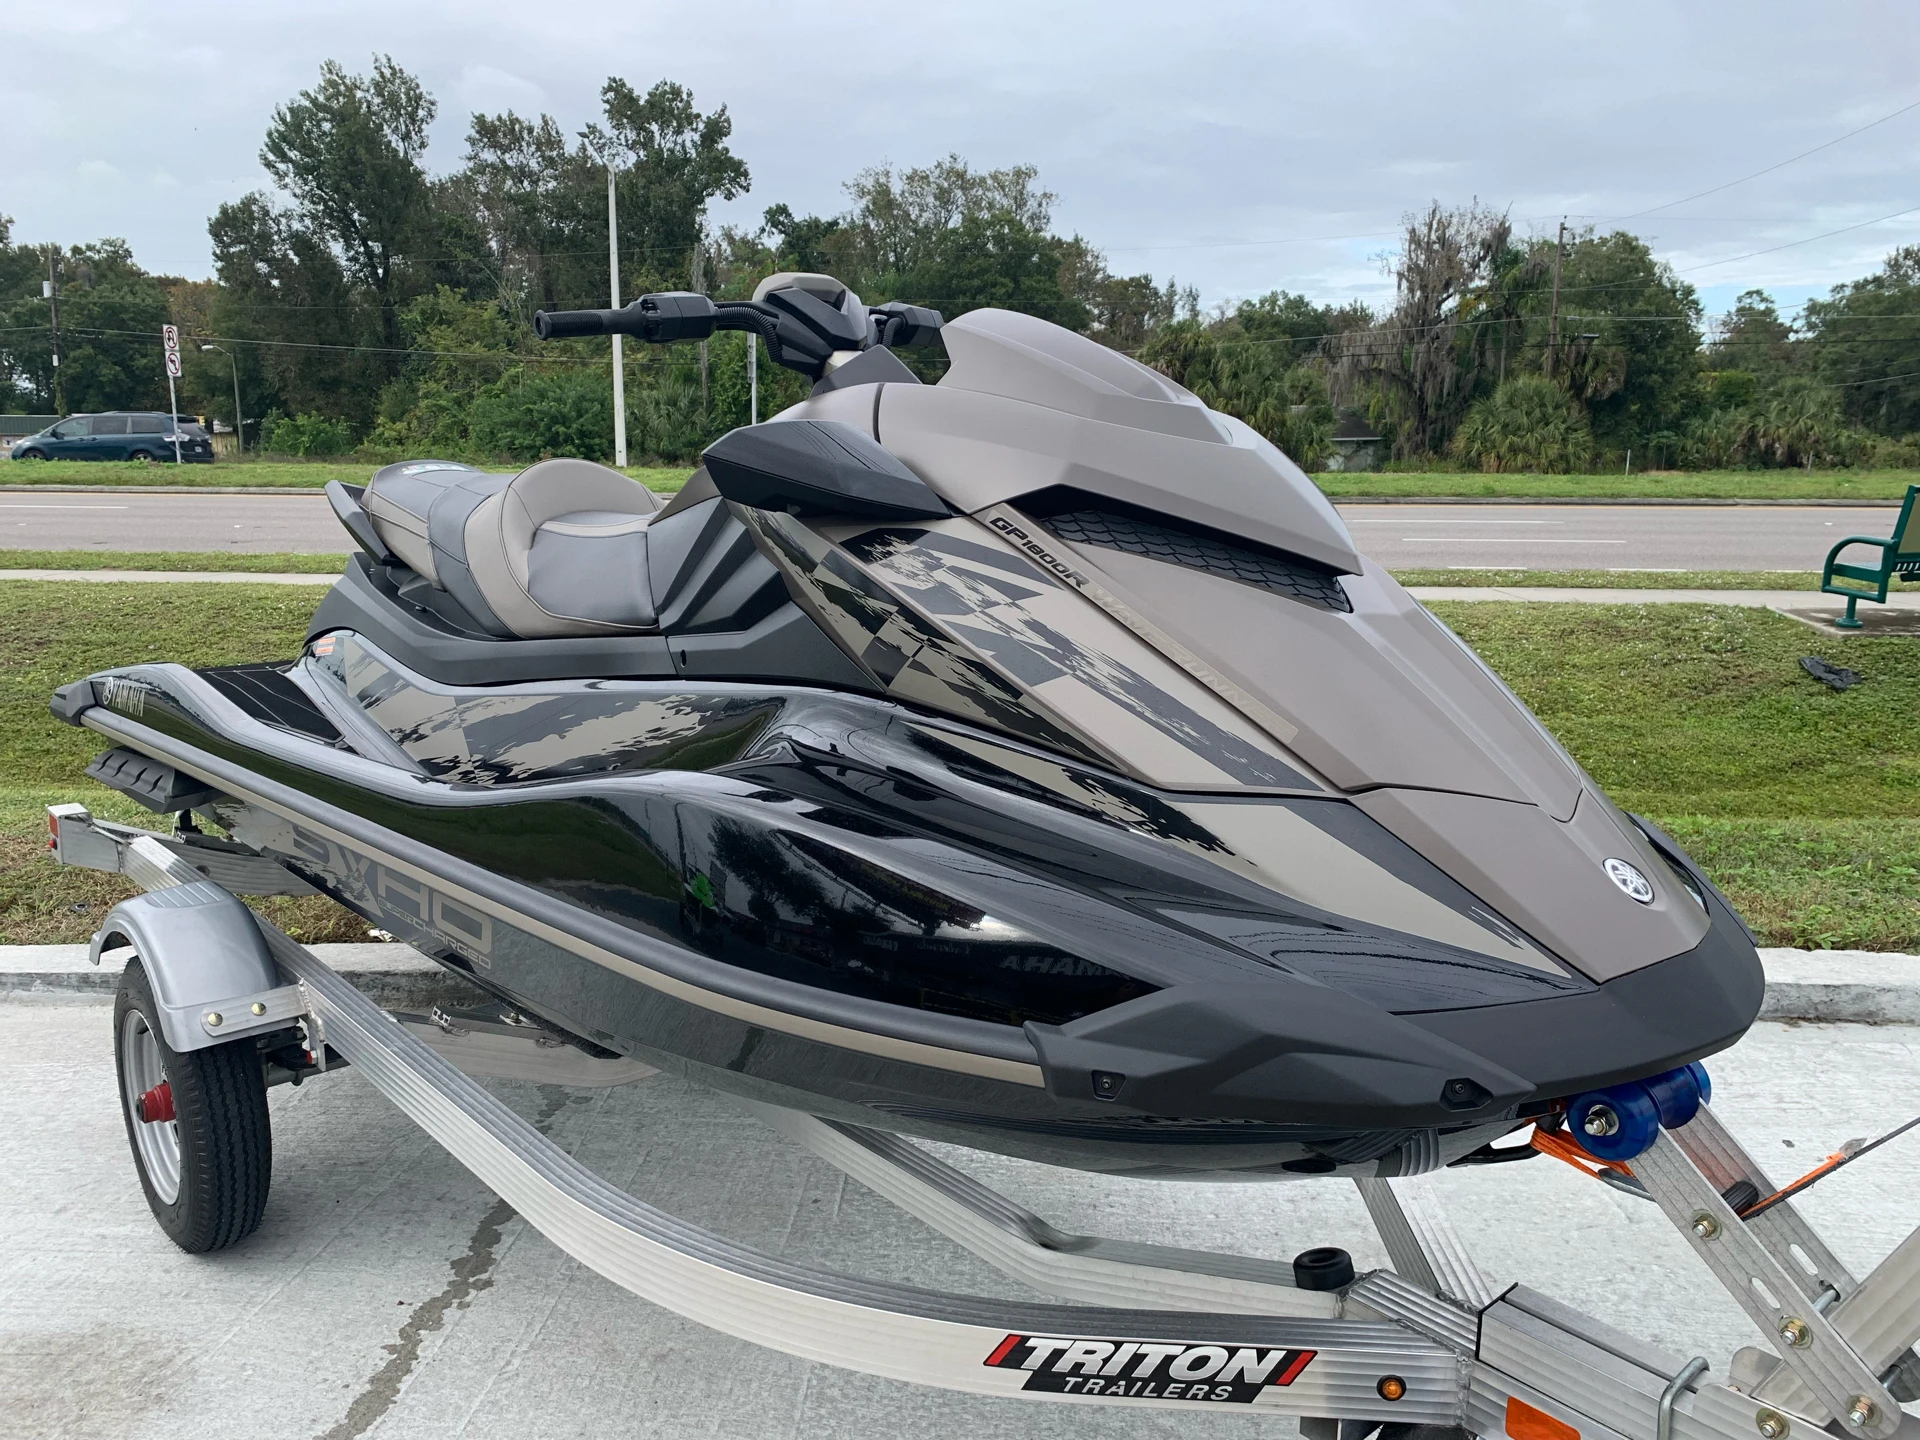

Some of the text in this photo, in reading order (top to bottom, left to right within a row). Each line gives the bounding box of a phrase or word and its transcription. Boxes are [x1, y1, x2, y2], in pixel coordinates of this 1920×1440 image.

[989, 516, 1090, 588] GP1800R
[112, 680, 145, 717] YAMAHA
[378, 899, 491, 970] SUPERCHARGED
[1020, 1337, 1288, 1384] TRITON
[1063, 1377, 1233, 1401] TRAILERS
